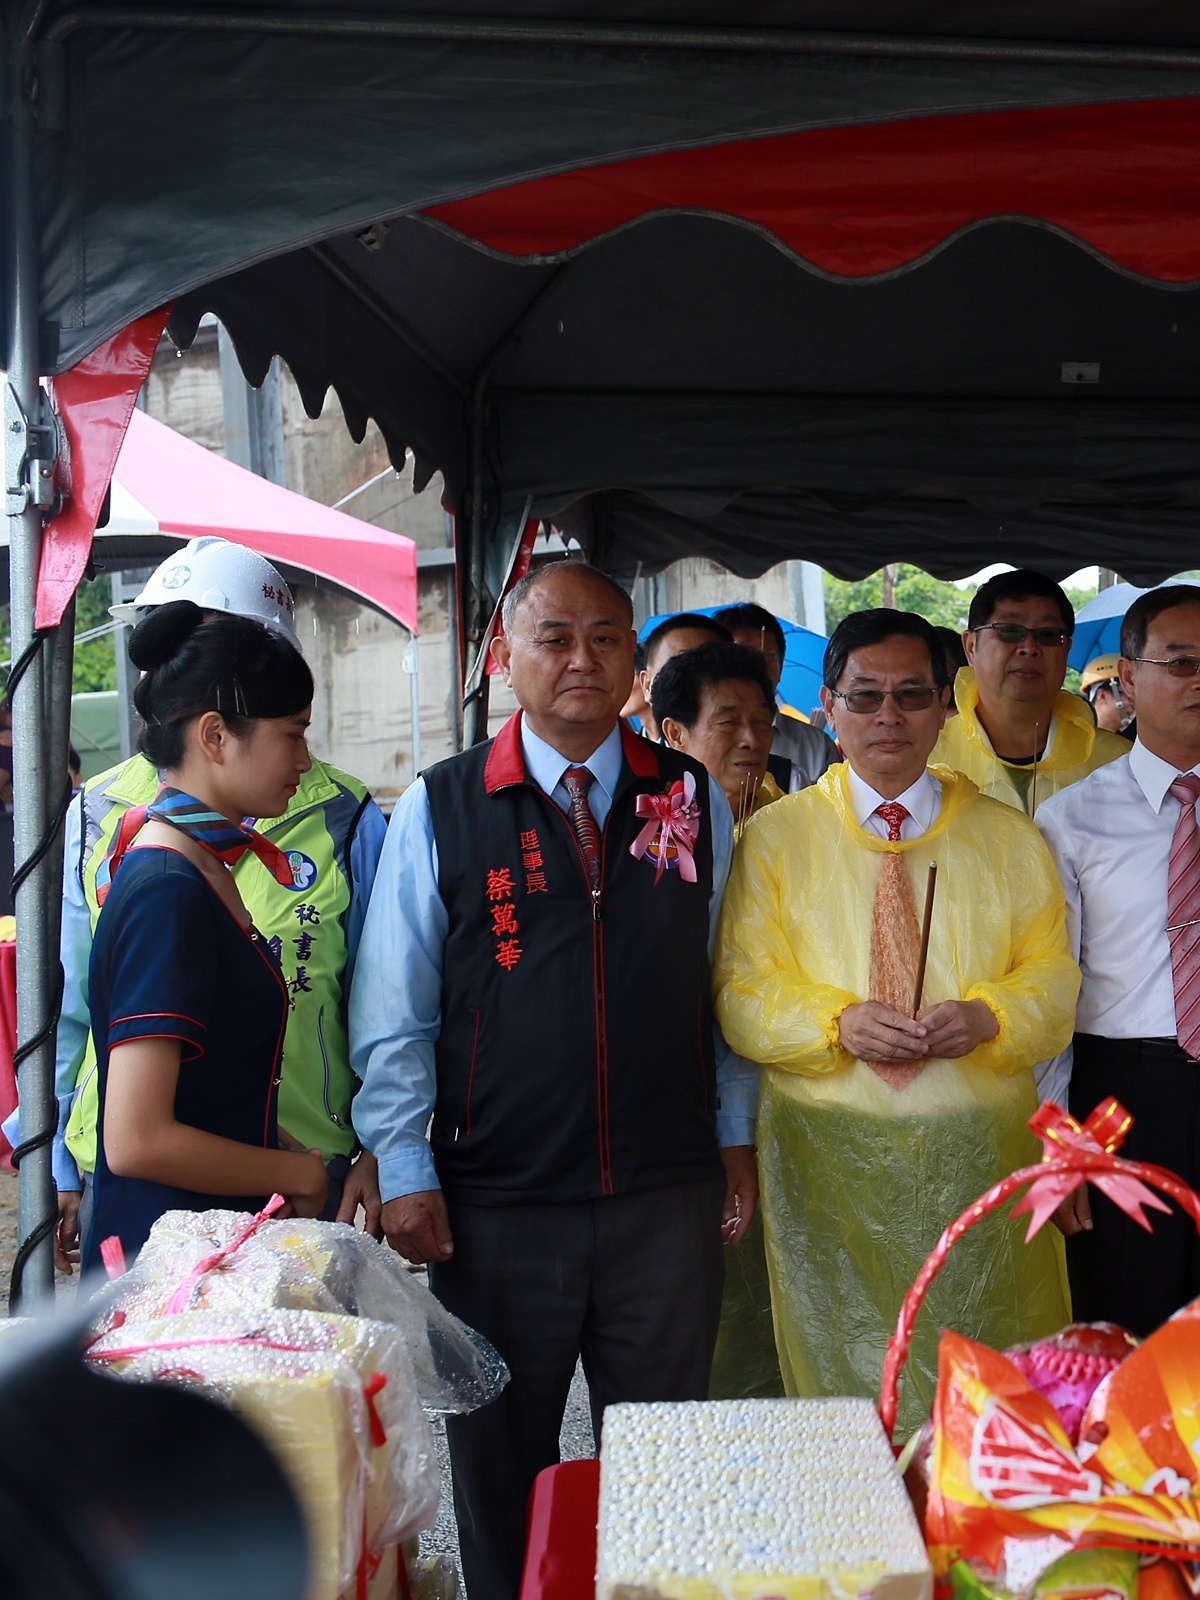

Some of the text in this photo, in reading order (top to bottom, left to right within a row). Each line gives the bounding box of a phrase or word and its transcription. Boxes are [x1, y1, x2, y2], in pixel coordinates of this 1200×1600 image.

[519, 829, 548, 894] 理事長
[290, 903, 321, 994] 秘書長
[485, 867, 523, 971] 蔡萬華
